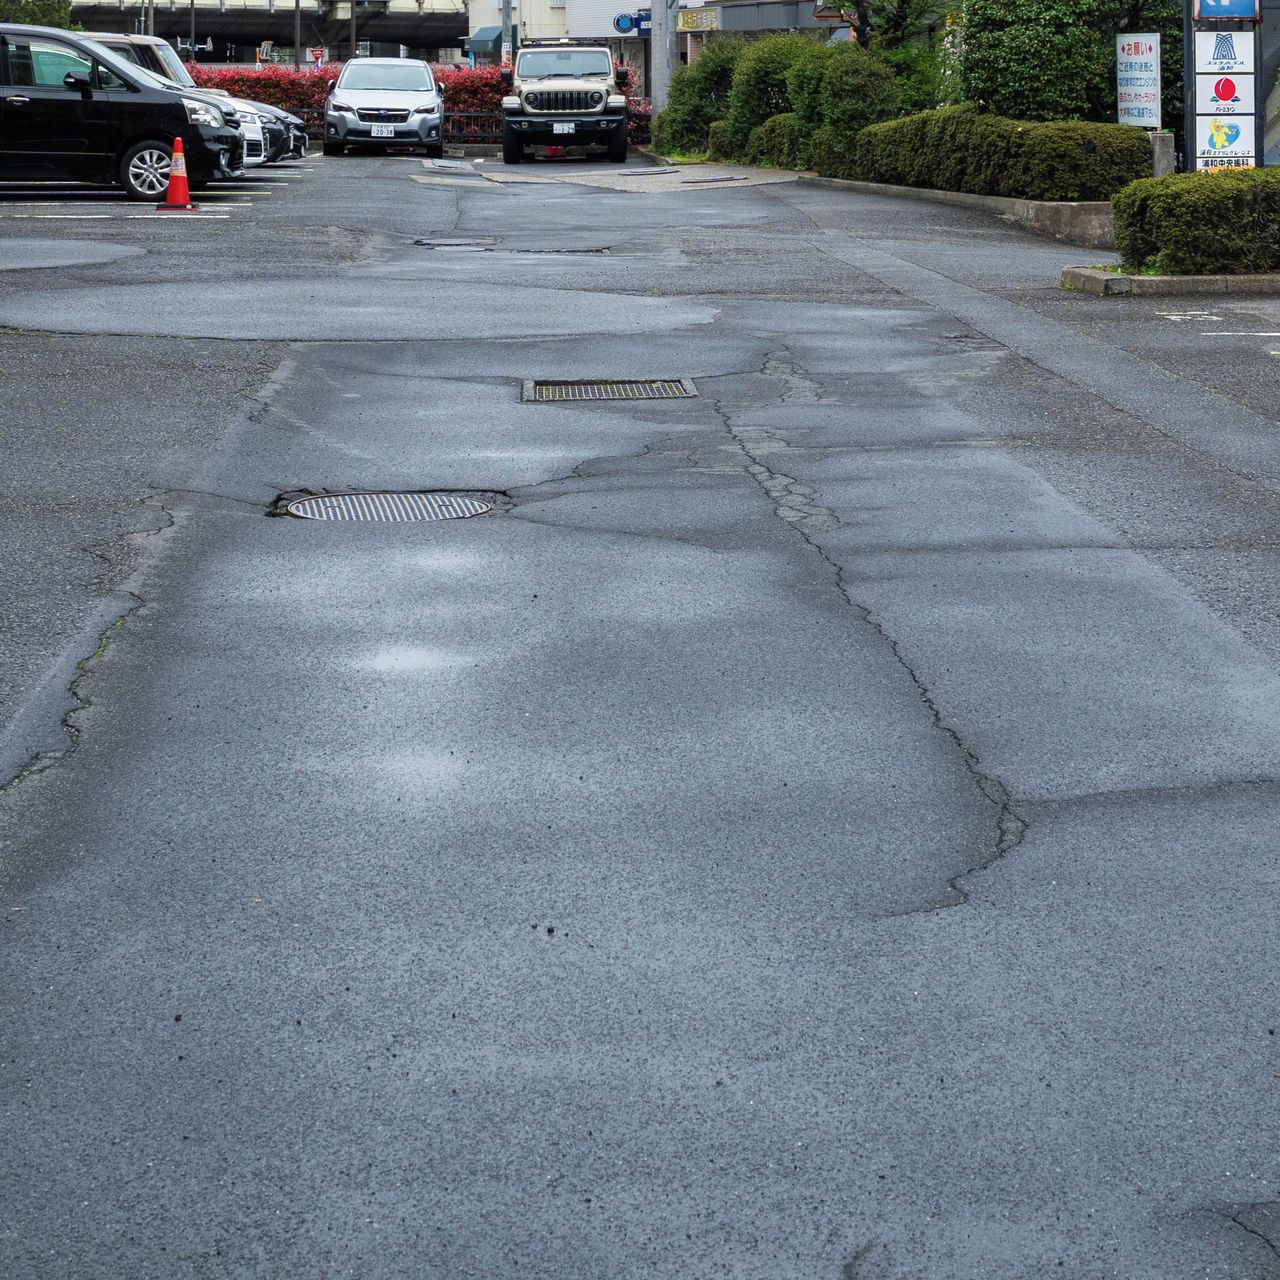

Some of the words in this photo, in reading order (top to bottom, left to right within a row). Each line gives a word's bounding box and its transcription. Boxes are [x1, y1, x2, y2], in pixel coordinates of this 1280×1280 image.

[1126, 41, 1148, 56] お願い
[1201, 159, 1249, 168] 浦和中央歯科
